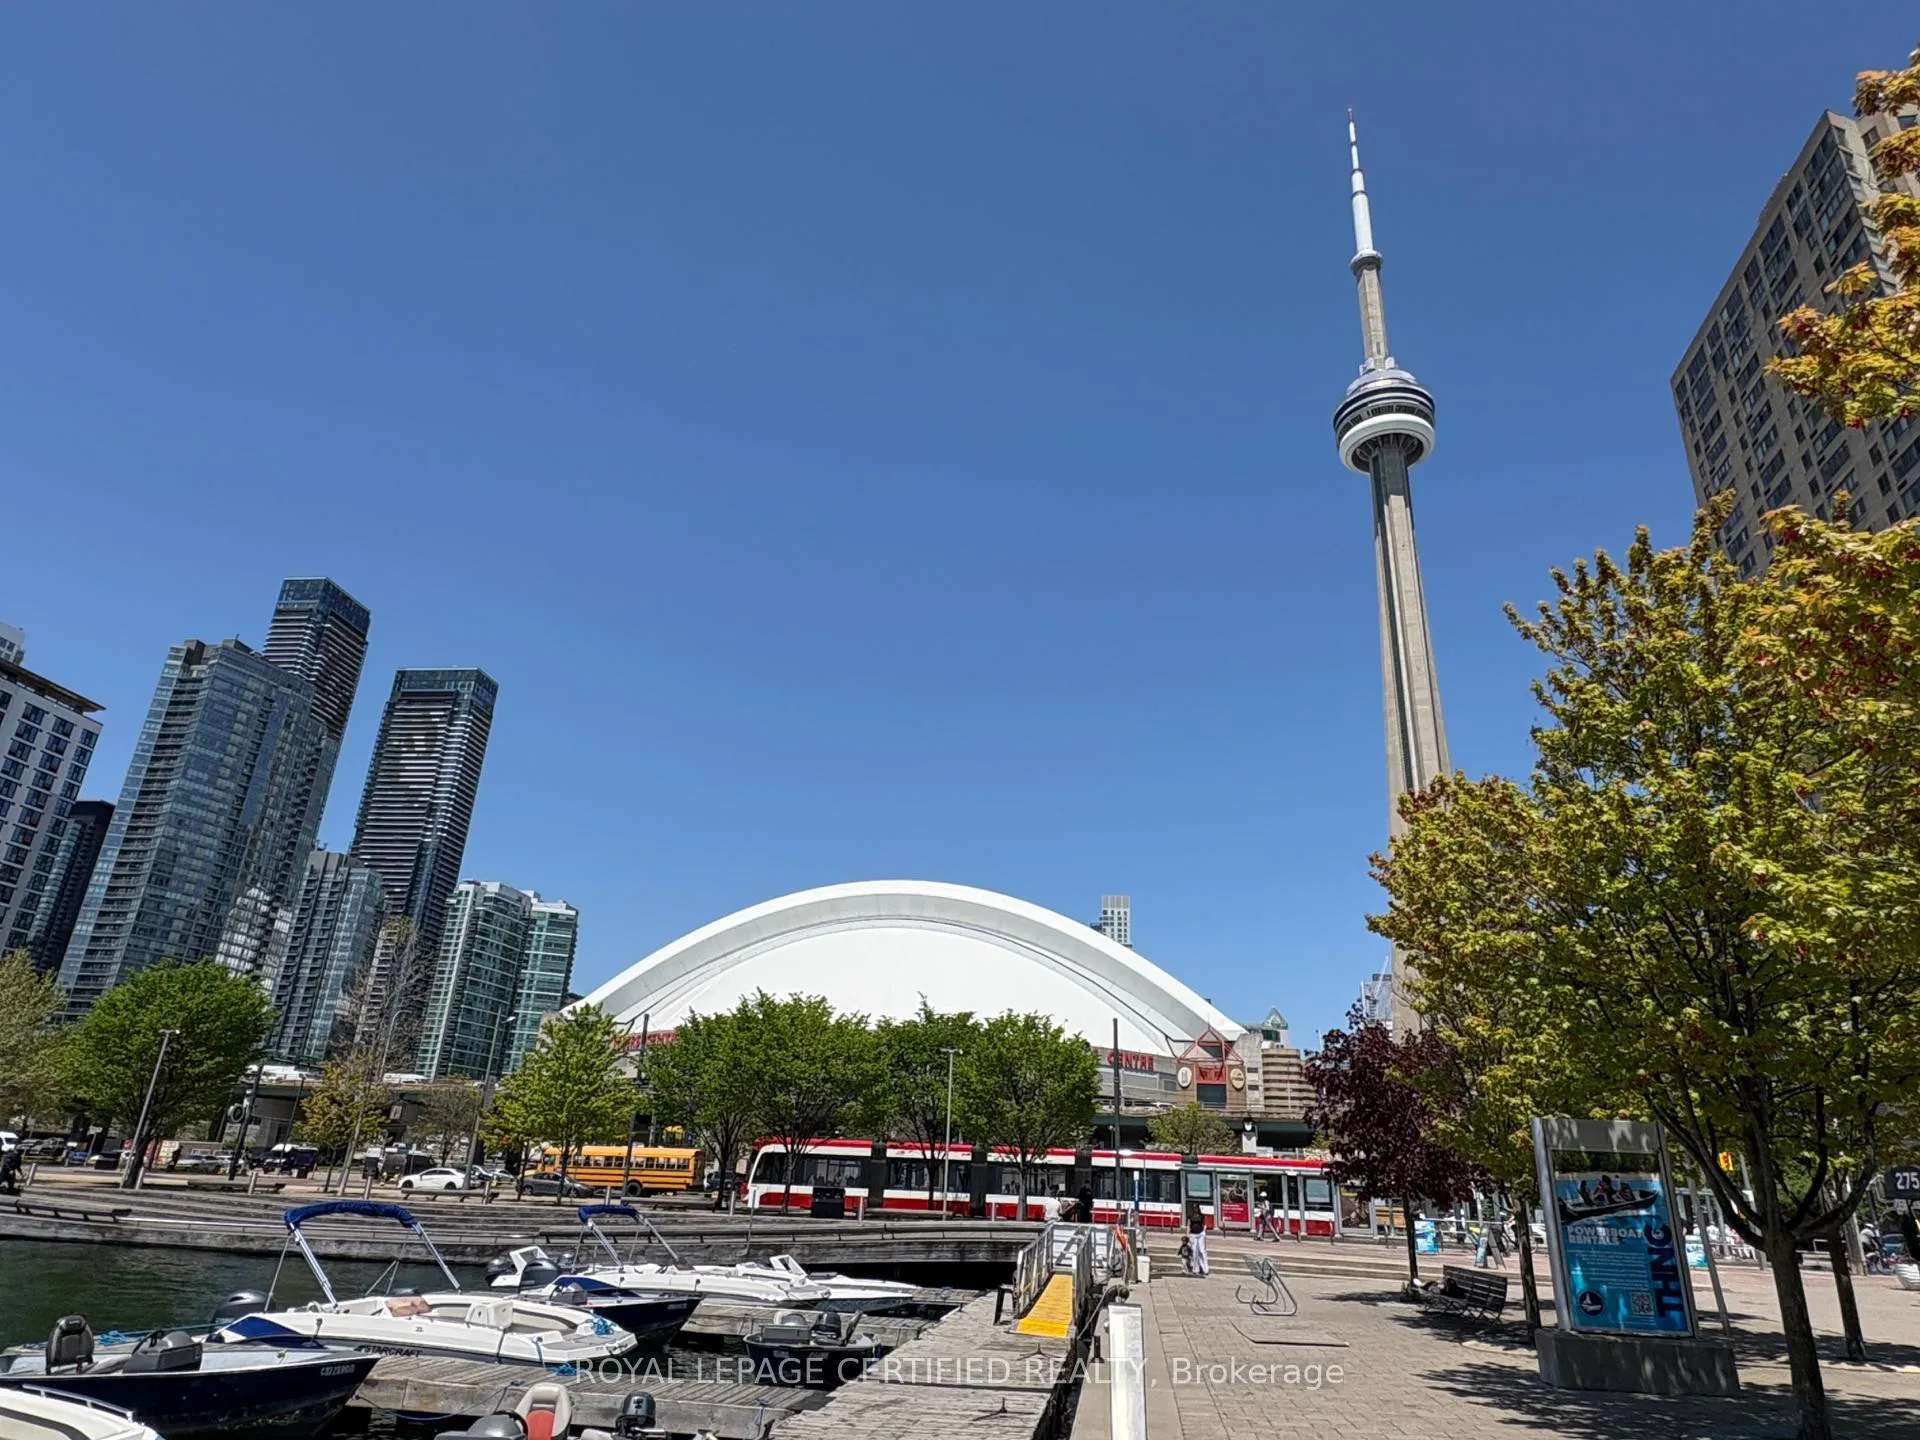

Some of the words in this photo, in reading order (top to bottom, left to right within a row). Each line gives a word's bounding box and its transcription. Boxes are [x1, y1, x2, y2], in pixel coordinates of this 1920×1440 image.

[1895, 1172, 1920, 1189] 275
[1567, 1226, 1643, 1238] POWERBOAT
[1568, 1235, 1620, 1246] RENTALS
[365, 1344, 423, 1357] STARCRAFT
